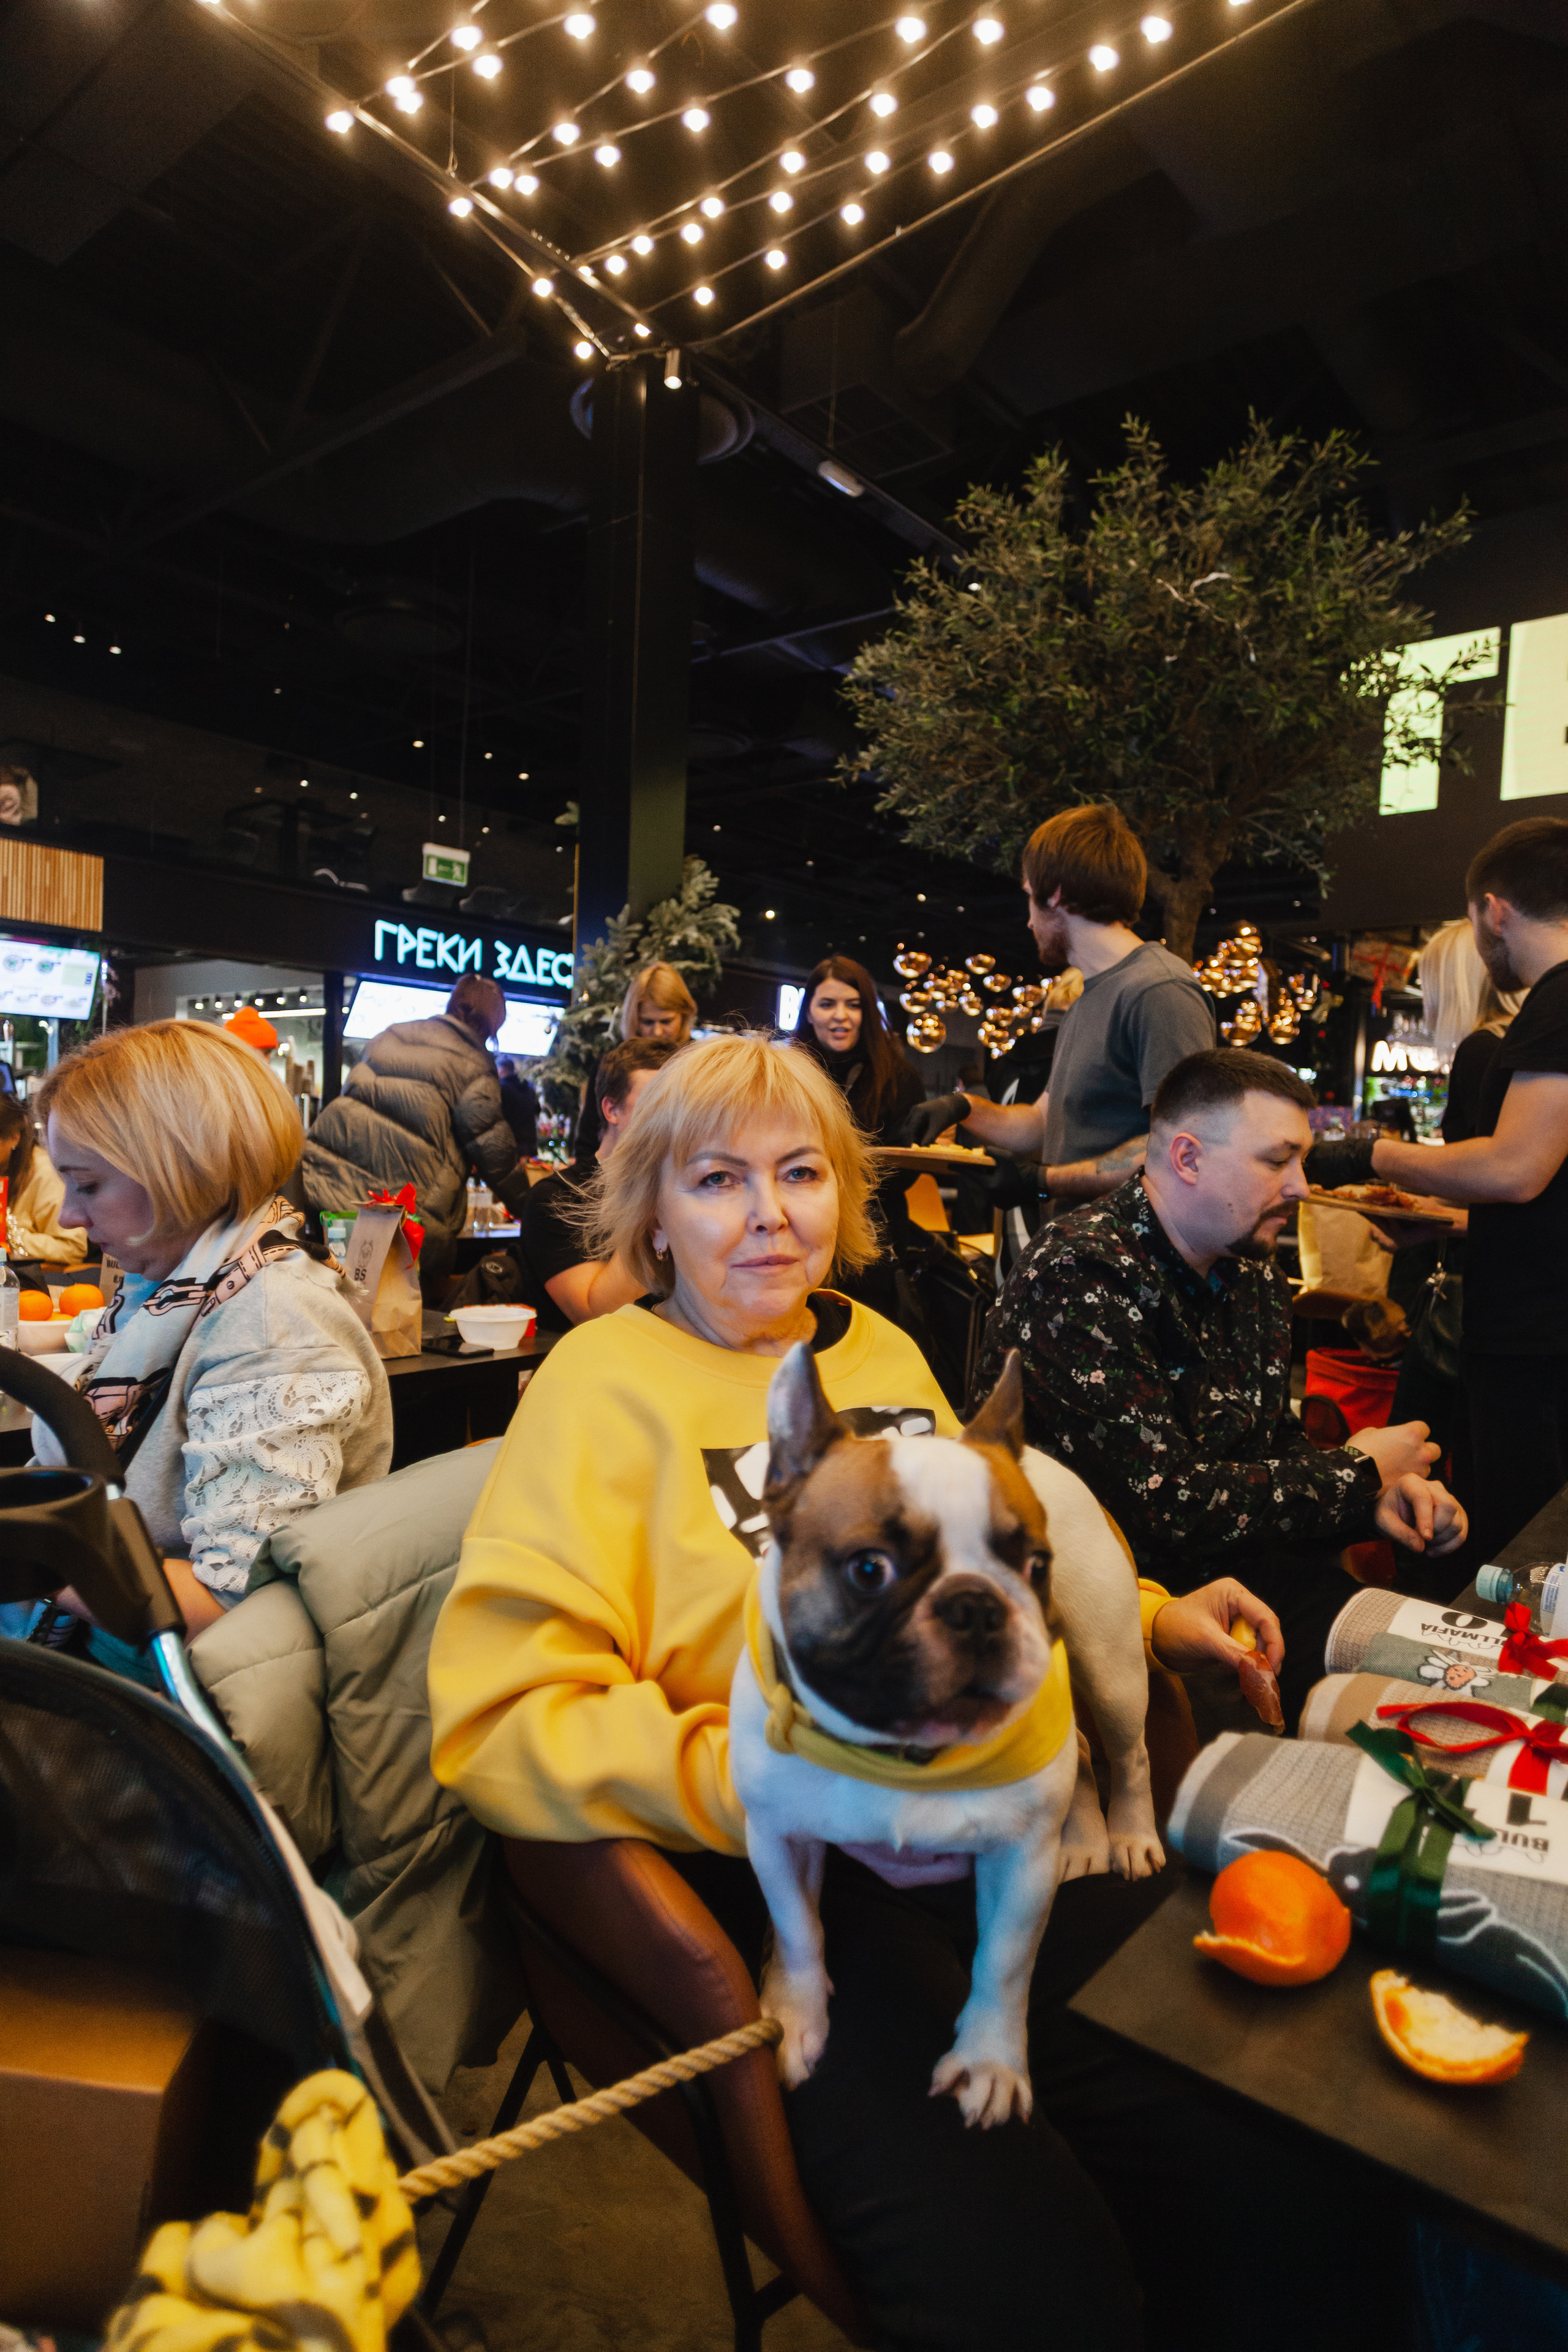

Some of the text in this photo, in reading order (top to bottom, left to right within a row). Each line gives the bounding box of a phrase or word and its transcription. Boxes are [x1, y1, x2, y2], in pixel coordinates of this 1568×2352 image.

[375, 919, 575, 989] ГРЕКИ ЗДЕС
[355, 1268, 367, 1281] BS
